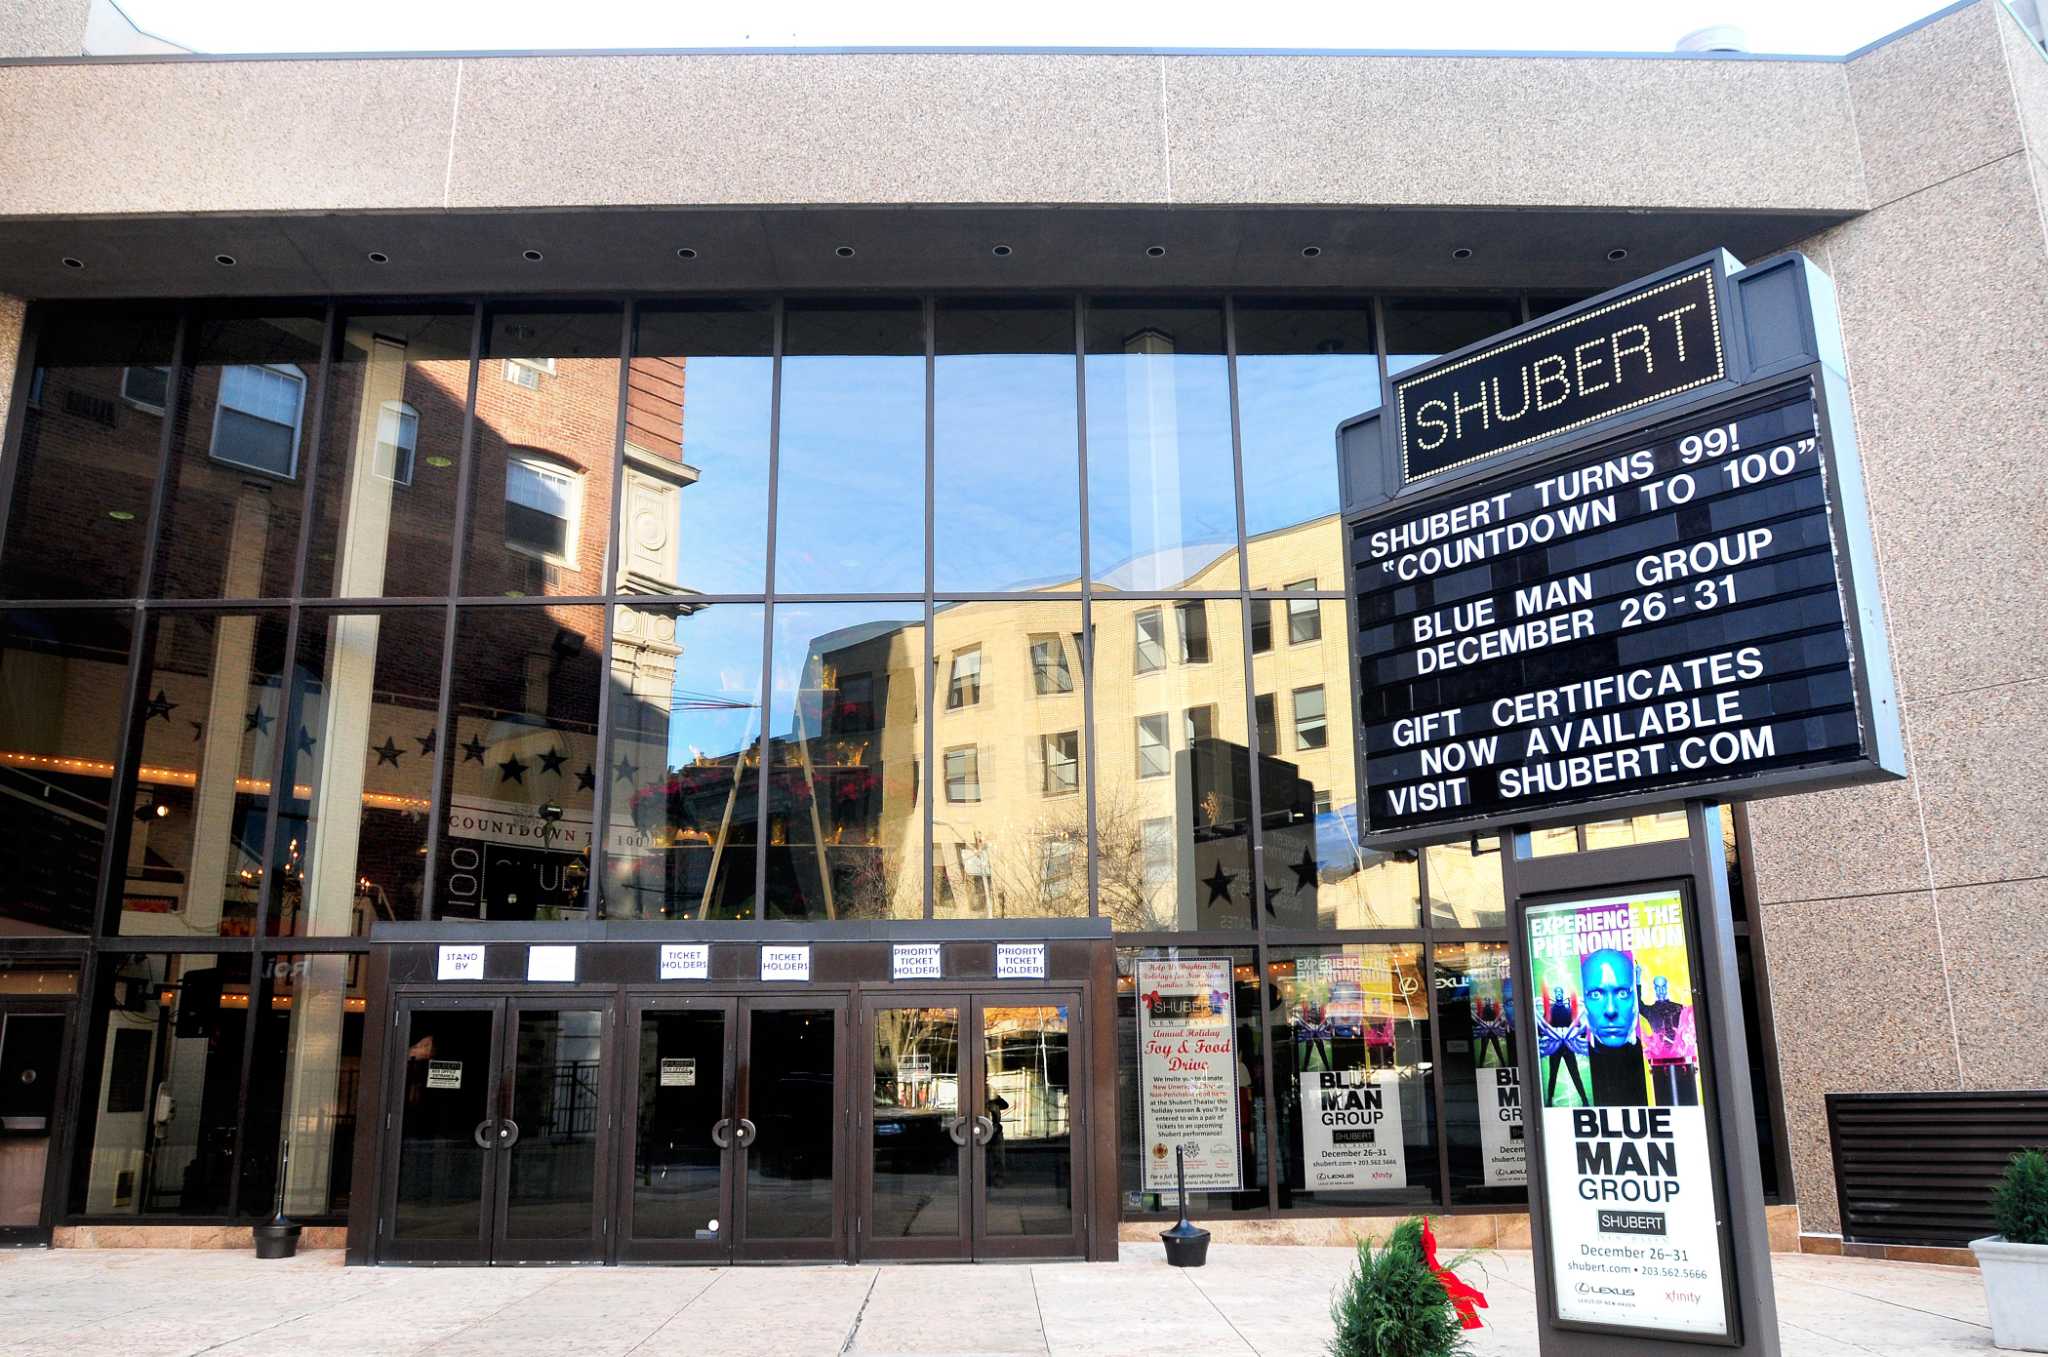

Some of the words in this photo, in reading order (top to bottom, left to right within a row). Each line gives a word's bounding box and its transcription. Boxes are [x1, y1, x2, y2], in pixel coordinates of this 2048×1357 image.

[1416, 303, 1697, 450] SHUBERT
[1370, 492, 1511, 559] SHUBERT
[1535, 451, 1654, 508] TURNS
[1679, 423, 1741, 464] 99!
[1640, 473, 1696, 512] TO
[1413, 598, 1495, 643] BLUE
[1515, 573, 1593, 617] MAN
[1635, 528, 1773, 587] GROUP
[1416, 609, 1596, 675] DECEMBER
[1392, 708, 1461, 748] GIFT
[1492, 647, 1764, 728] CERTIFICATES
[1421, 736, 1498, 777] NOW
[1526, 690, 1743, 758] AVAILABLE
[1388, 778, 1466, 816] VISIT
[1500, 725, 1775, 798] SHUBERT.COM
[449, 815, 576, 841] COUNTDOWN
[1531, 909, 1641, 937] EXPERIENCE
[1646, 904, 1681, 925] THE
[1533, 926, 1686, 959] PHENOMENON
[447, 953, 478, 961] STAND
[669, 952, 701, 960] TICKET
[769, 953, 802, 961] TICKET
[894, 948, 940, 956] PRIORITY
[998, 947, 1045, 955] PRIORITY
[455, 962, 468, 970] BY
[662, 961, 707, 969] HOLDERS
[763, 962, 808, 971] HOLDERS
[901, 957, 934, 965] TICKET
[1004, 957, 1037, 965] TICKET
[894, 966, 940, 975] HOLDERS
[998, 966, 1044, 974] HOLDERS
[1435, 977, 1470, 989] EXU
[1153, 1030, 1184, 1038] Annual
[1186, 1029, 1221, 1039] Holiday
[1144, 1040, 1171, 1057] Toy
[1178, 1040, 1189, 1053] &
[1195, 1039, 1231, 1054] Food
[1168, 1057, 1208, 1071] Drive
[1496, 1068, 1521, 1087] BL
[1321, 1090, 1383, 1111] MAN
[1321, 1111, 1384, 1126] GROUP
[1573, 1108, 1674, 1140] BLUE
[1335, 1131, 1373, 1141] SHUBERT
[1321, 1149, 1361, 1158] December
[1500, 1146, 1526, 1154] Decem
[1576, 1142, 1678, 1177] MAN
[1578, 1179, 1681, 1203] GROUP
[1601, 1214, 1663, 1230] SHUBERT
[1580, 1244, 1645, 1259] December
[1568, 1260, 1632, 1274] shubert.com
[1641, 1266, 1708, 1280] 203.562.5666
[1590, 1286, 1636, 1297] LEXUS
[1665, 1290, 1701, 1304] xfinity
